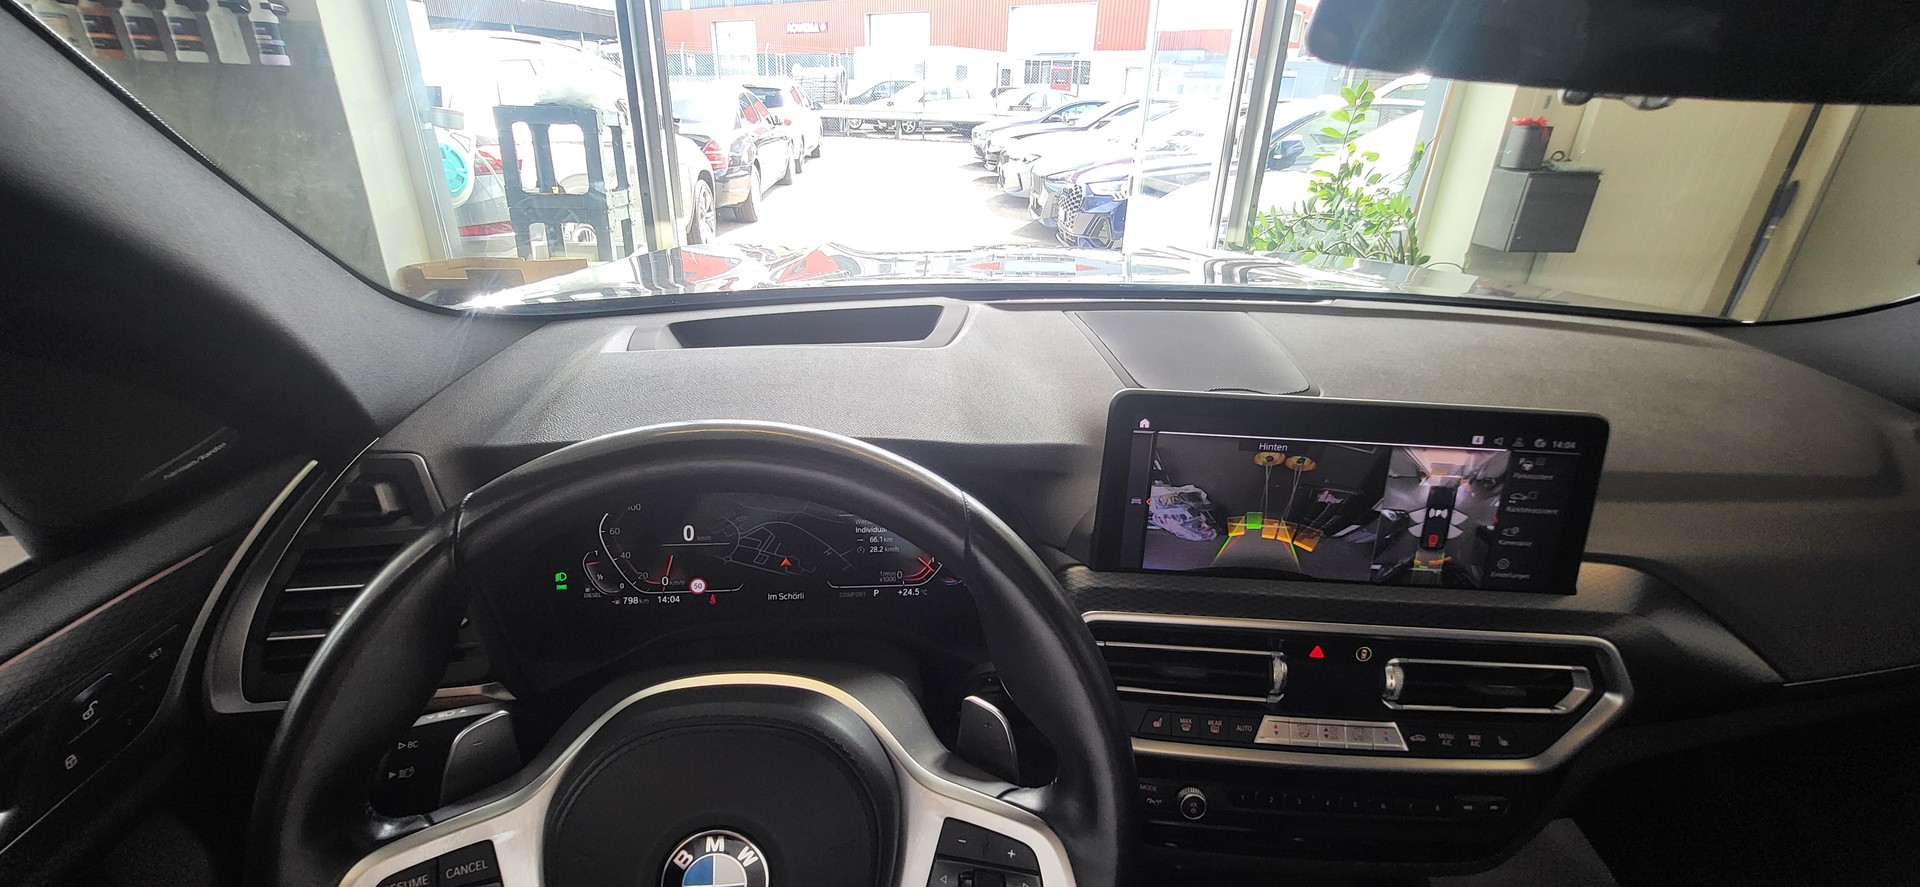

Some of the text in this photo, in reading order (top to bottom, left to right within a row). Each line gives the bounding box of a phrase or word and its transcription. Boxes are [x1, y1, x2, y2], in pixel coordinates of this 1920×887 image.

[1259, 443, 1288, 452] Hinten
[1553, 441, 1577, 449] 14:04
[610, 527, 621, 535] 60
[683, 525, 695, 542] 0
[621, 551, 632, 559] 40
[638, 572, 649, 580] 20
[897, 571, 903, 579] 0
[661, 576, 669, 586] 0
[873, 589, 880, 597] P
[897, 588, 920, 596] +24.5
[622, 596, 639, 605] 798
[657, 595, 681, 603] 14:04
[767, 592, 805, 601] Im Schörli
[148, 647, 163, 661] SET
[1236, 724, 1253, 732] AUTO
[407, 740, 419, 749] BC
[445, 859, 489, 879] CANCEL
